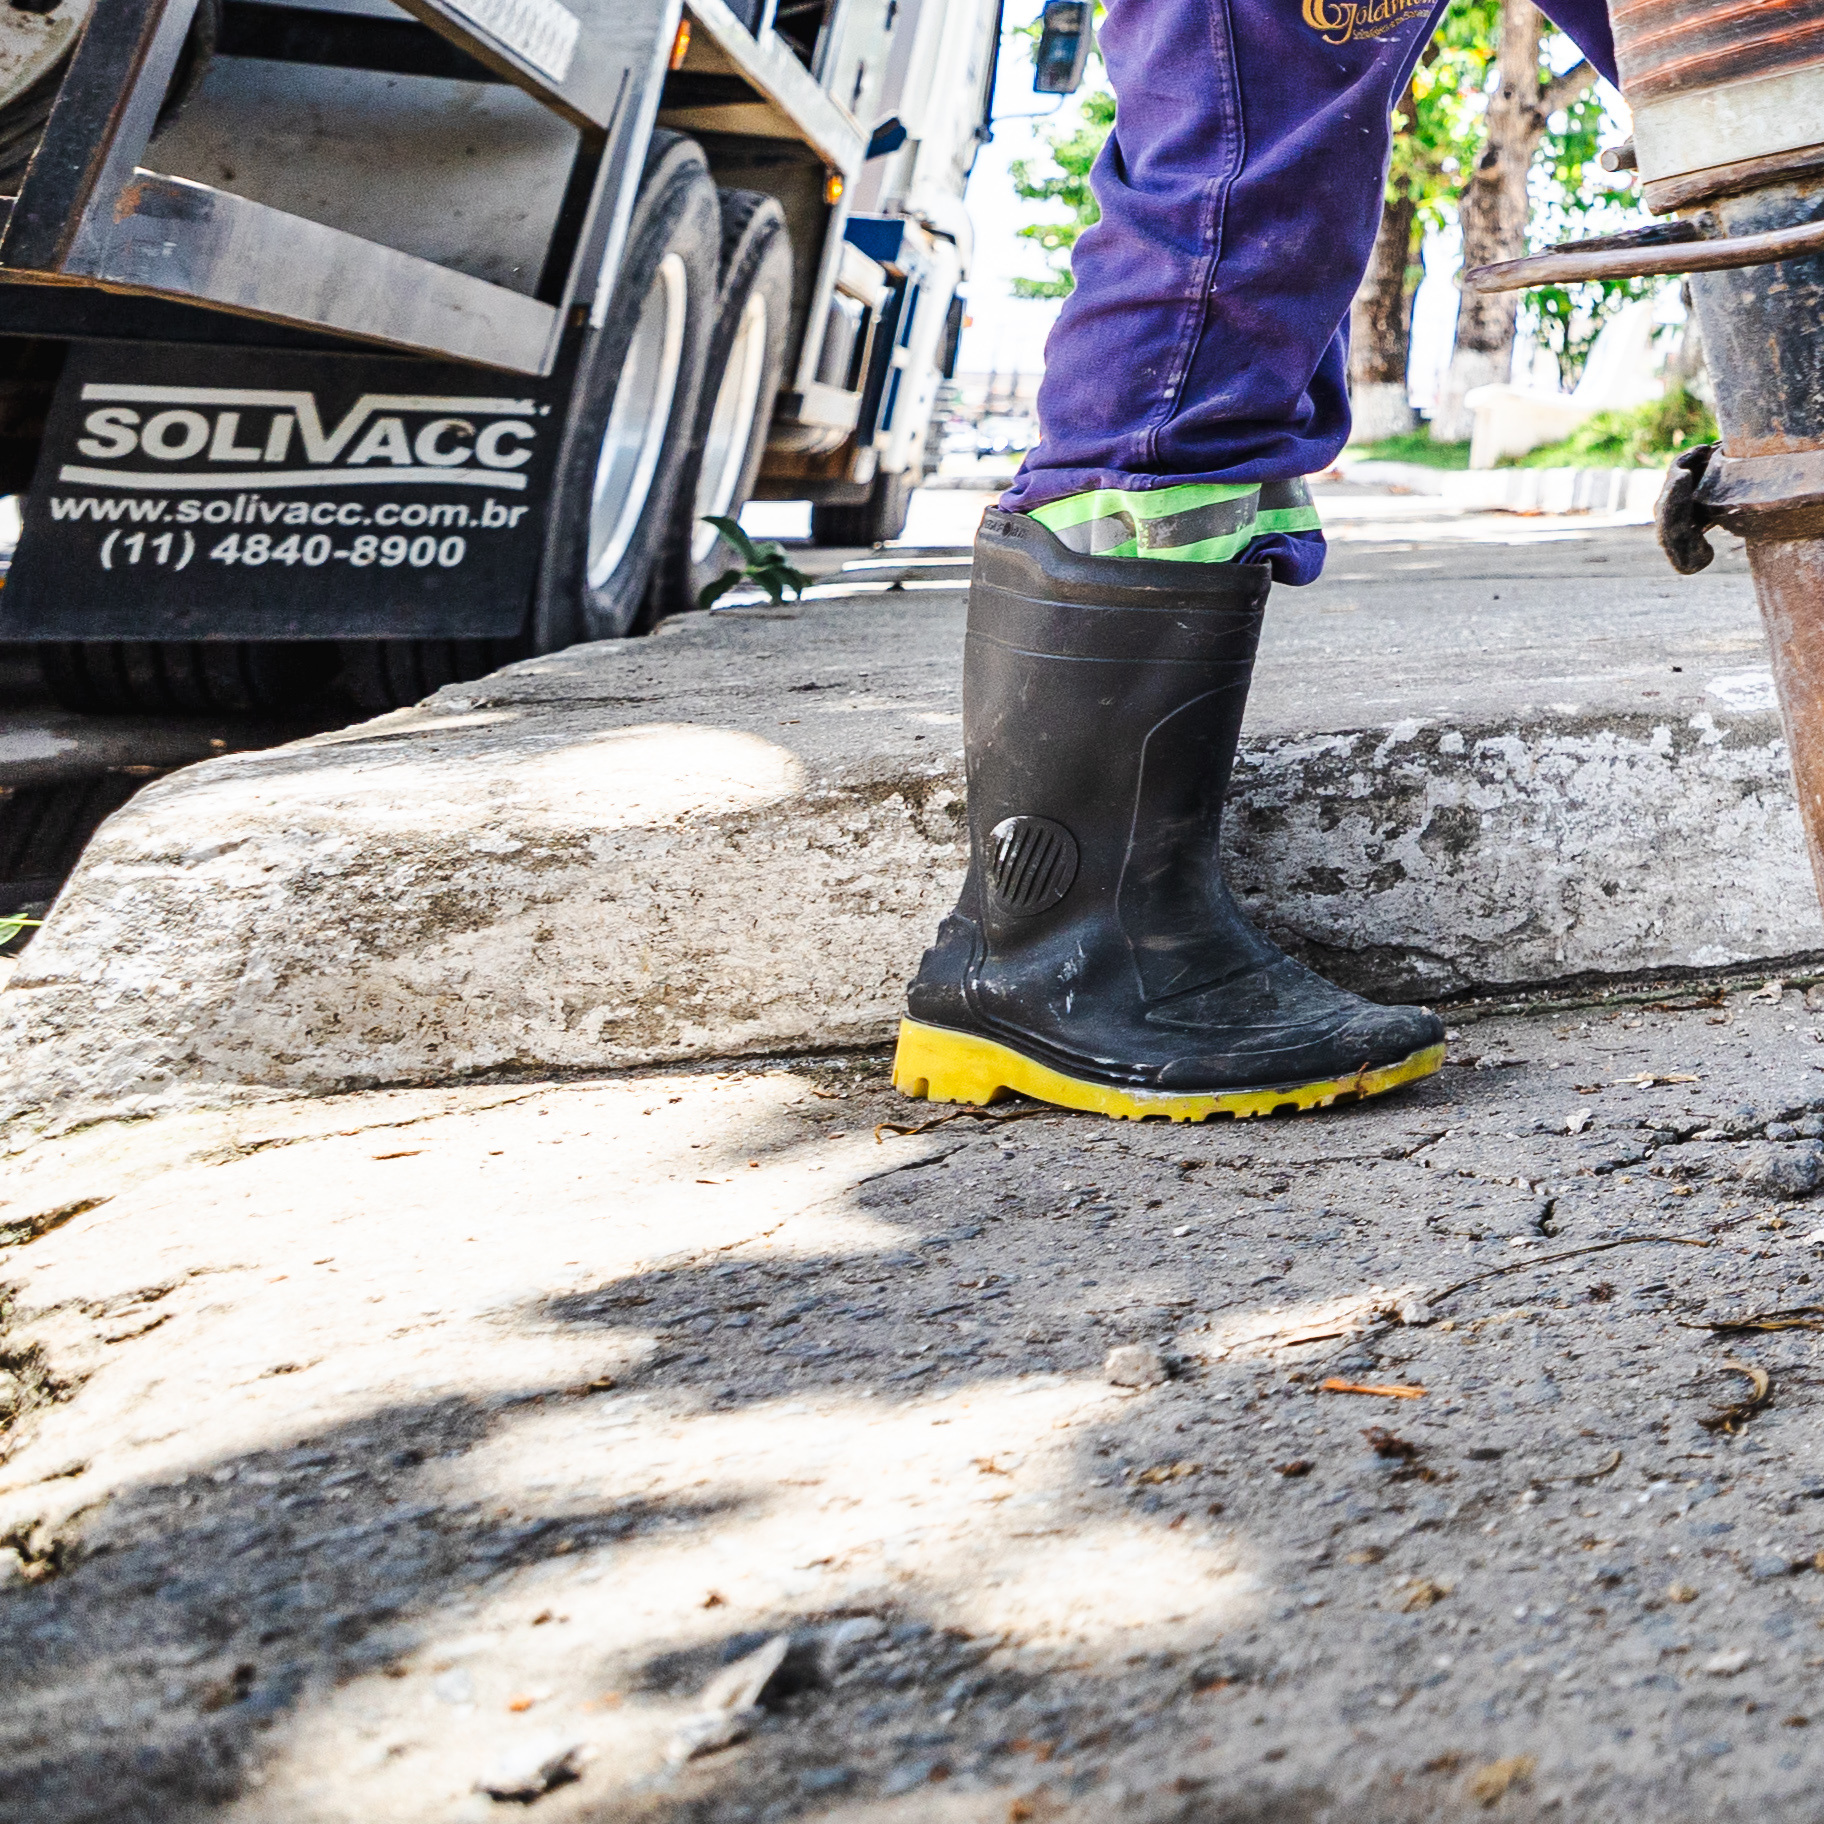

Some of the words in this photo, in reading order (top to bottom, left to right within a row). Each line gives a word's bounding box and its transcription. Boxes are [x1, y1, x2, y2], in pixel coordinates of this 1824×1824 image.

[77, 390, 537, 469] SOLIVACC
[50, 492, 529, 529] www.solivacc.com.br
[100, 528, 195, 571] (11)
[210, 532, 466, 568] 4840-8900
